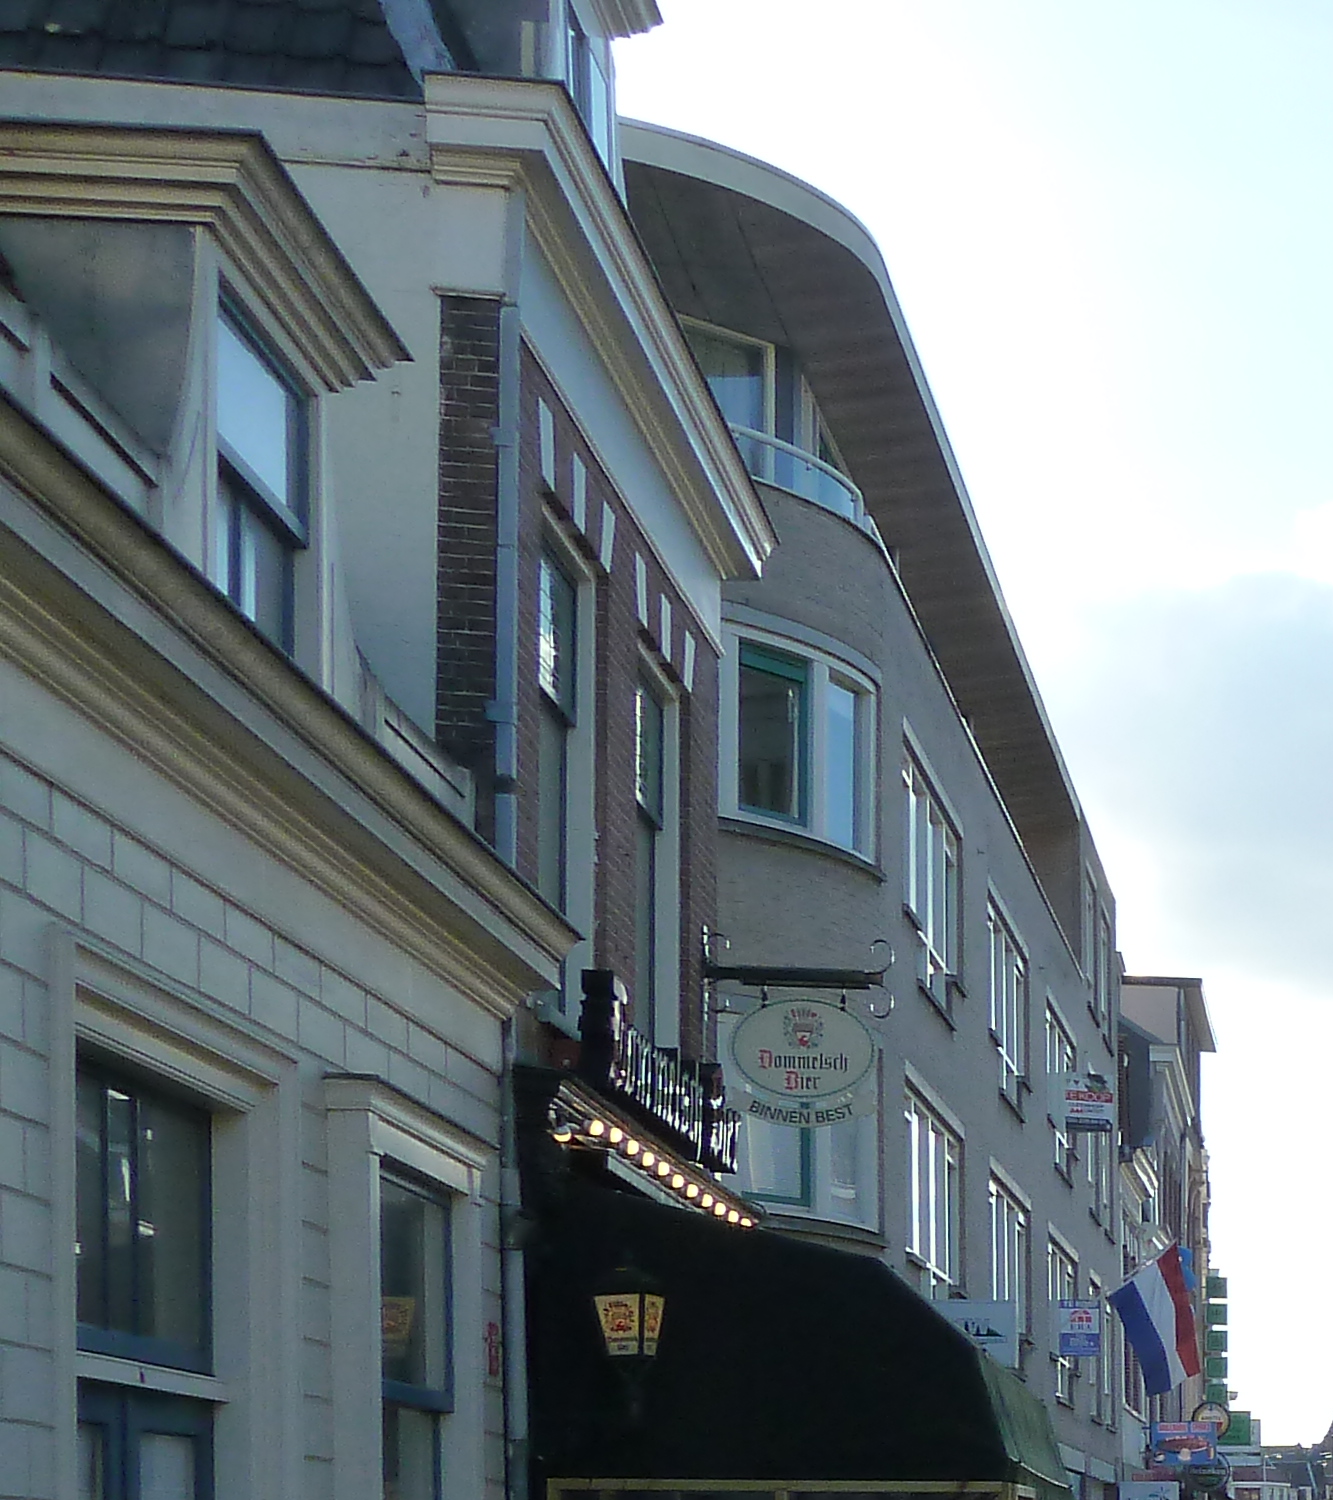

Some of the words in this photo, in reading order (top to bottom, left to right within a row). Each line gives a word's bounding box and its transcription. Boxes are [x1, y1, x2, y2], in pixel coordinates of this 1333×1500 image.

[758, 1049, 849, 1074] Dommelsch
[785, 1071, 821, 1091] Bier
[749, 1100, 810, 1124] BINNEN
[815, 1103, 853, 1123] BEST
